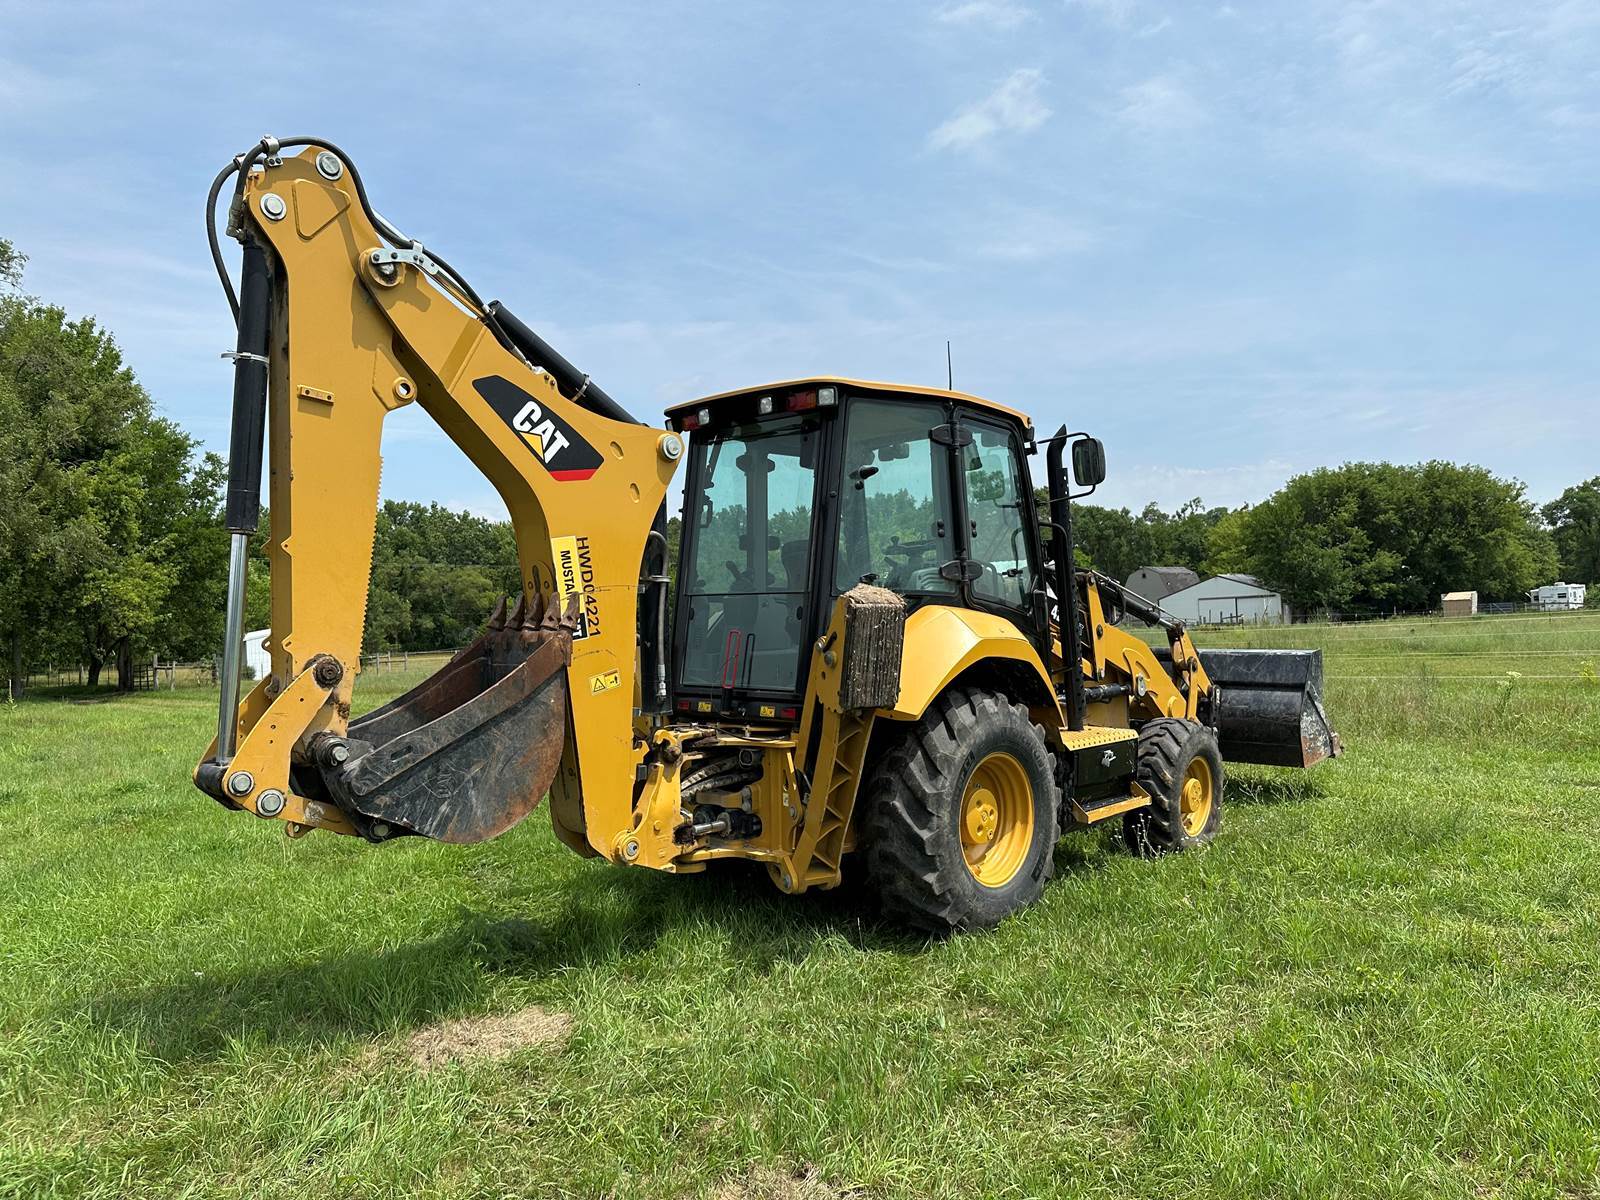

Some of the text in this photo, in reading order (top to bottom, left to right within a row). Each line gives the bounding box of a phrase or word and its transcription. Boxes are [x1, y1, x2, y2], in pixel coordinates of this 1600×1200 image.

[512, 400, 570, 464] CAT
[560, 550, 575, 596] MUSTA
[576, 536, 601, 636] HWD04221
